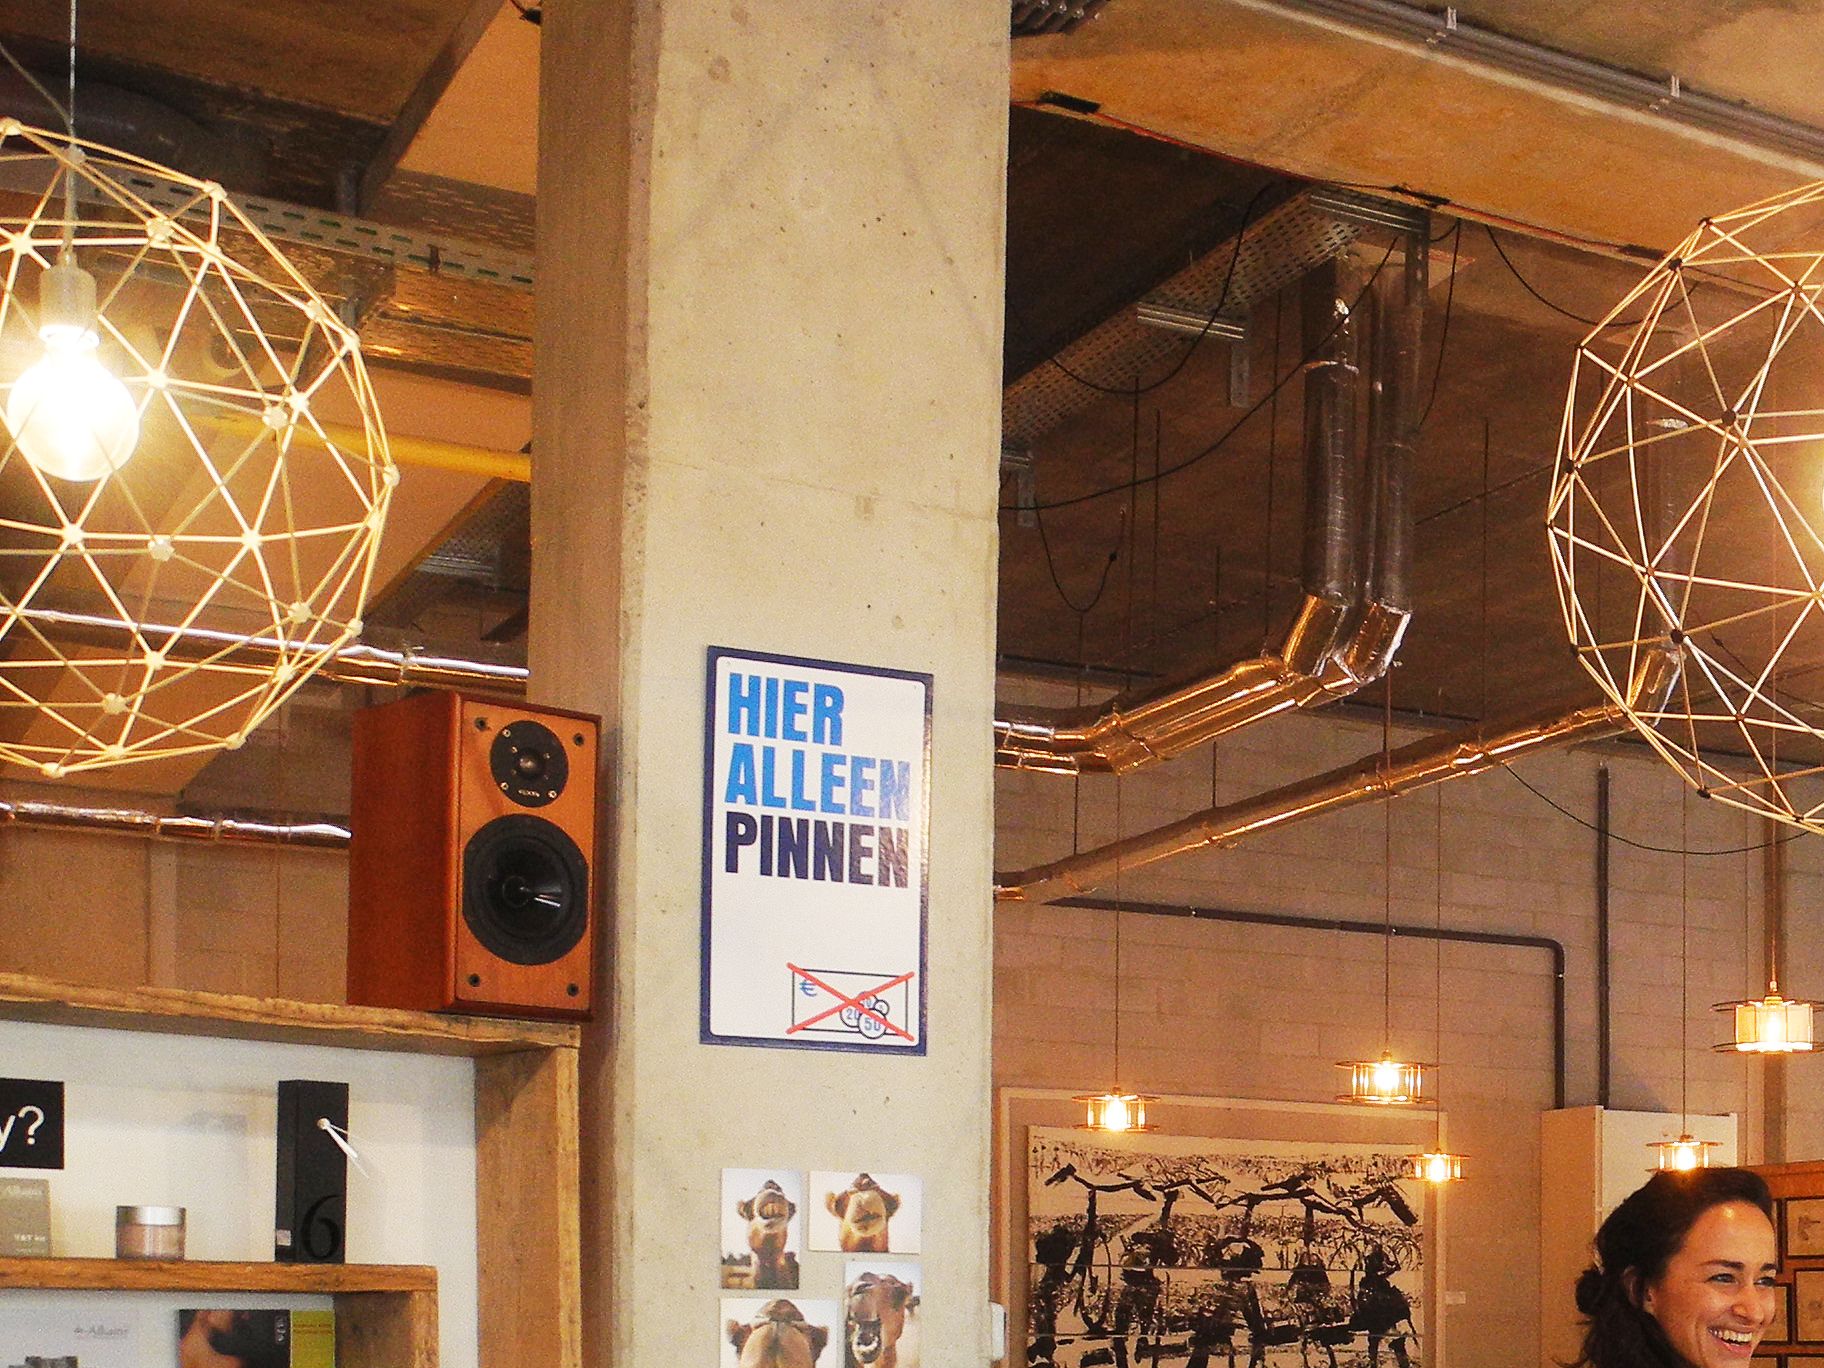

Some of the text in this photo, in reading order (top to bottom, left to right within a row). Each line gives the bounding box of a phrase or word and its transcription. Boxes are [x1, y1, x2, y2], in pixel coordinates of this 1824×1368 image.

[727, 672, 845, 747] HIER
[724, 742, 911, 822] ALLEEN
[725, 811, 910, 889] PINNEN
